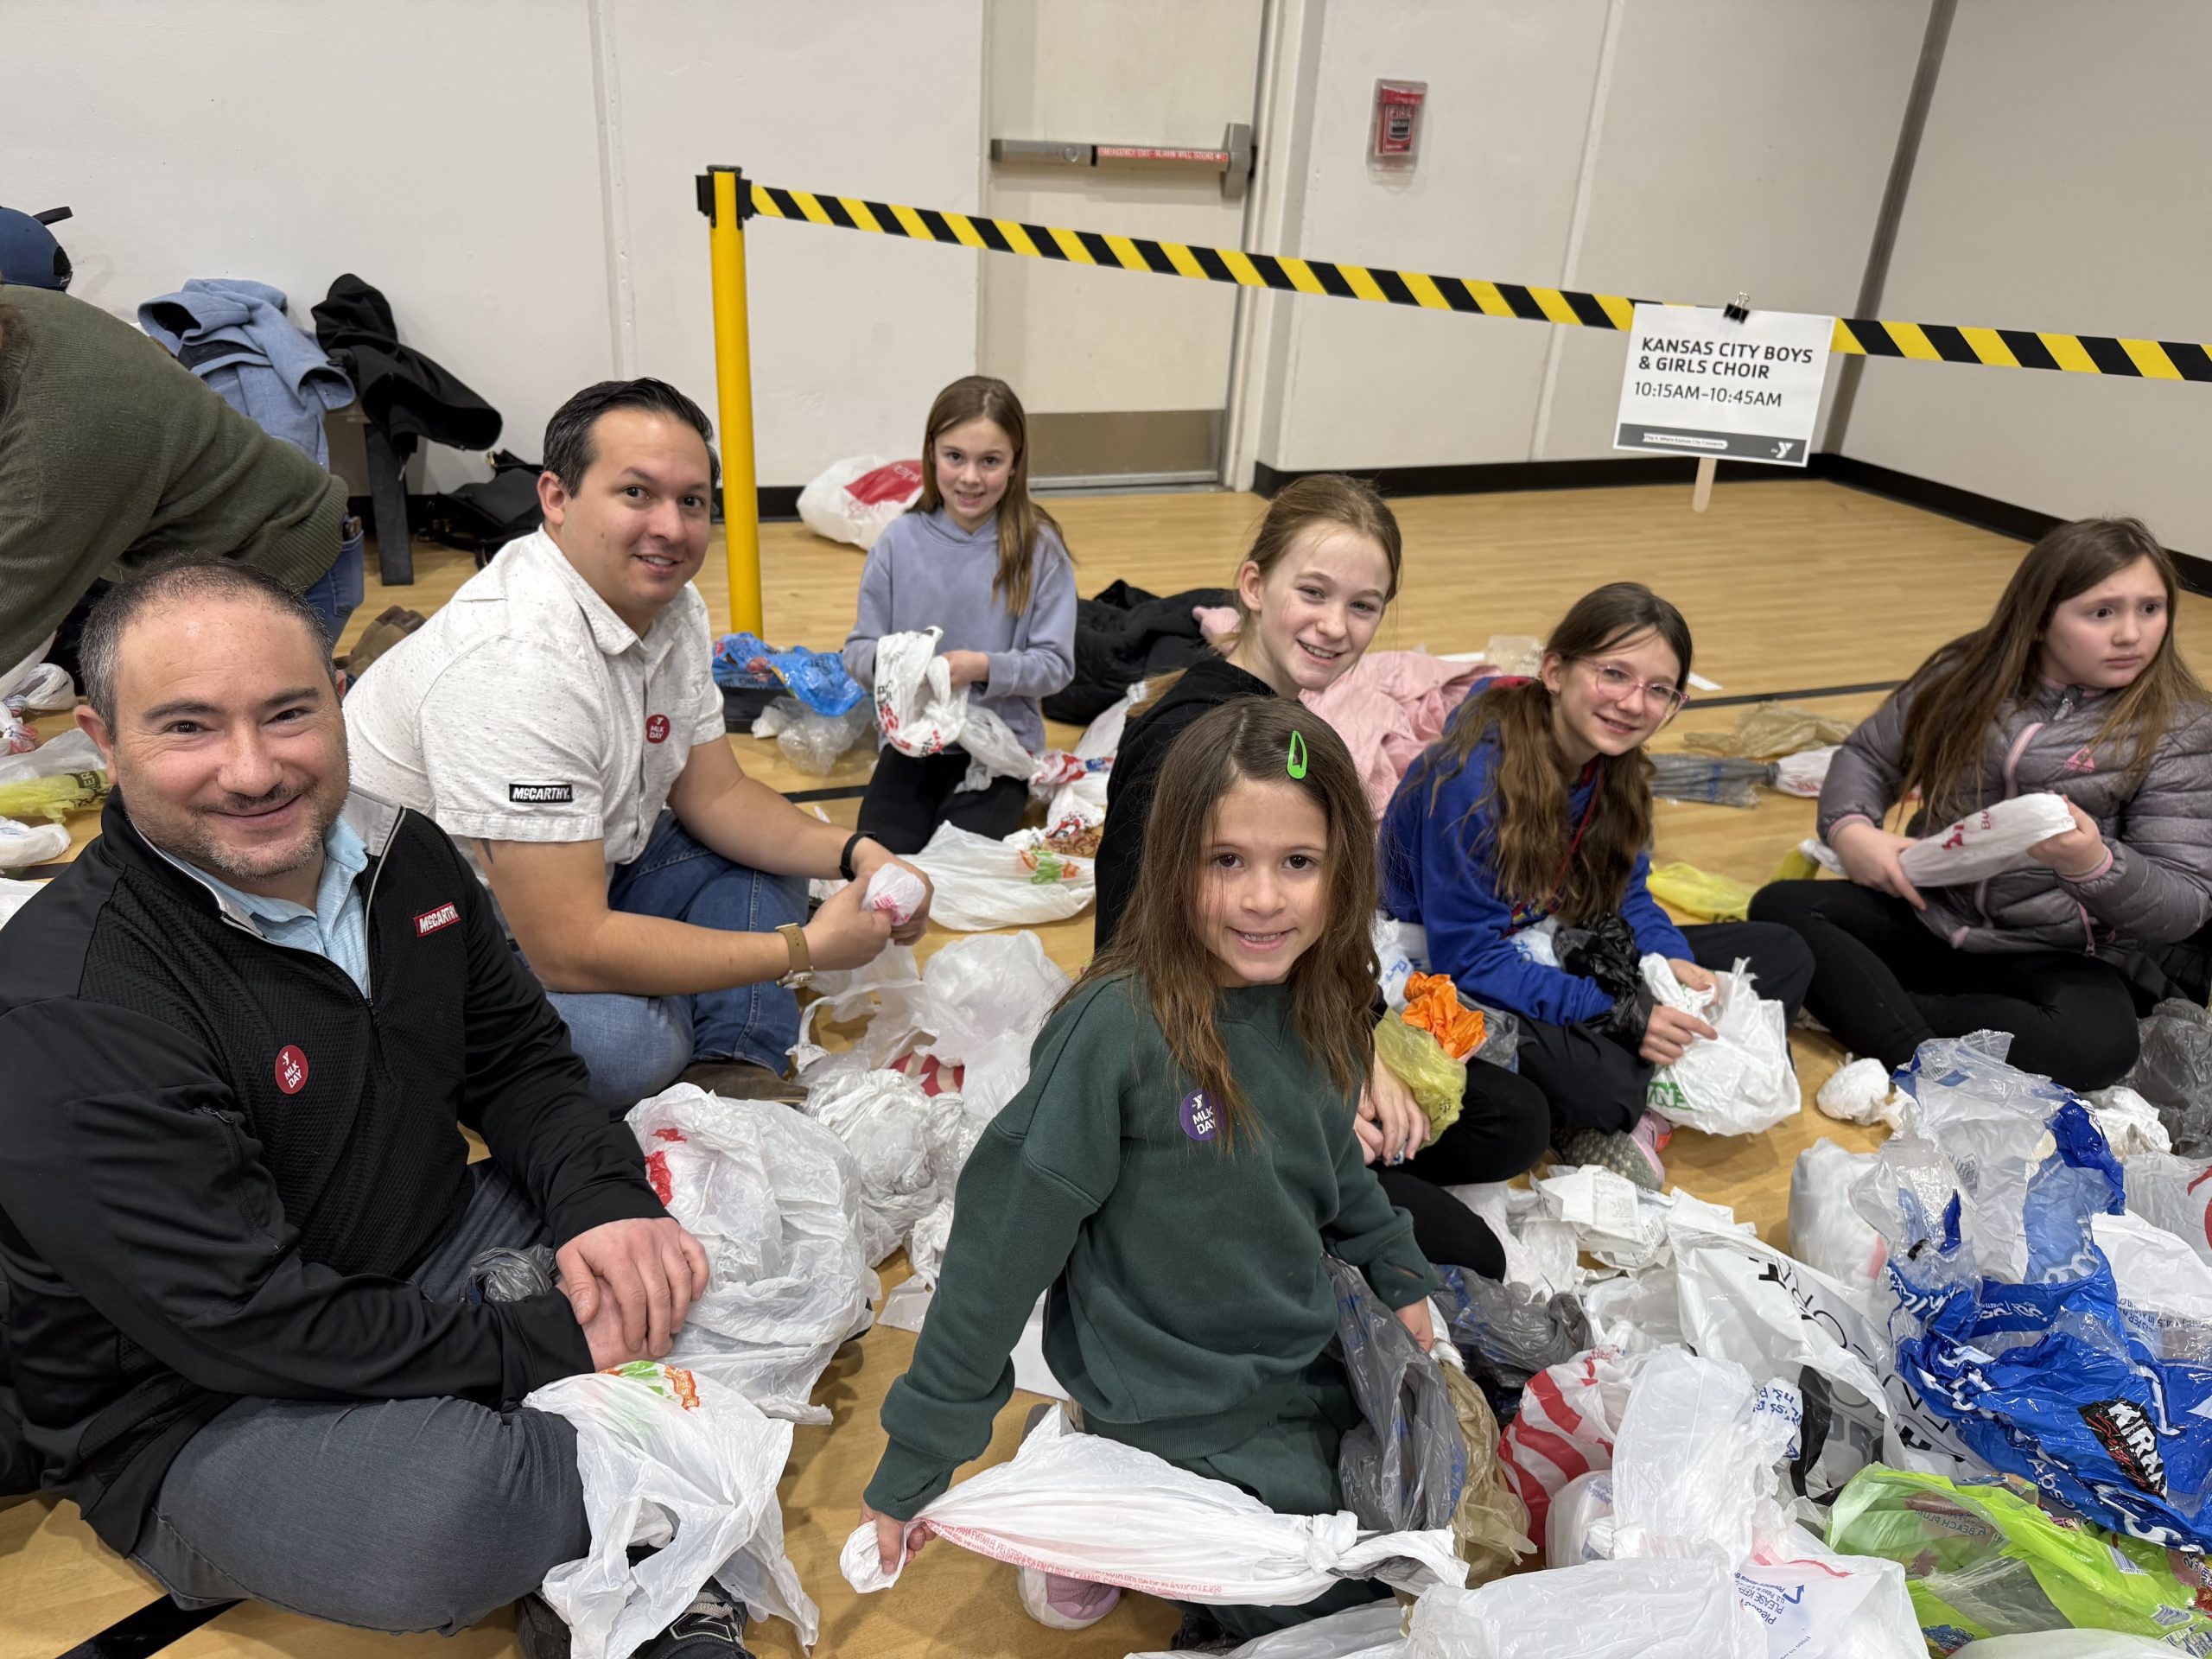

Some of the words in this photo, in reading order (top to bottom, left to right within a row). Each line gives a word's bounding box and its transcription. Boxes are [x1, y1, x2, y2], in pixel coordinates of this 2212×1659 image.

[1642, 337, 1714, 355] KANSAS
[1719, 342, 1759, 359] CITY
[1764, 346, 1814, 363] BOYS
[1638, 355, 1650, 370] &
[1656, 357, 1707, 374] GIRLS
[1712, 361, 1770, 379] CHOIR
[284, 1060, 299, 1081] MLK
[289, 1069, 302, 1088] DAY
[1192, 1106, 1214, 1125] MLK
[1197, 1117, 1216, 1135] DAY
[1754, 1592, 1785, 1615] PLEASE
